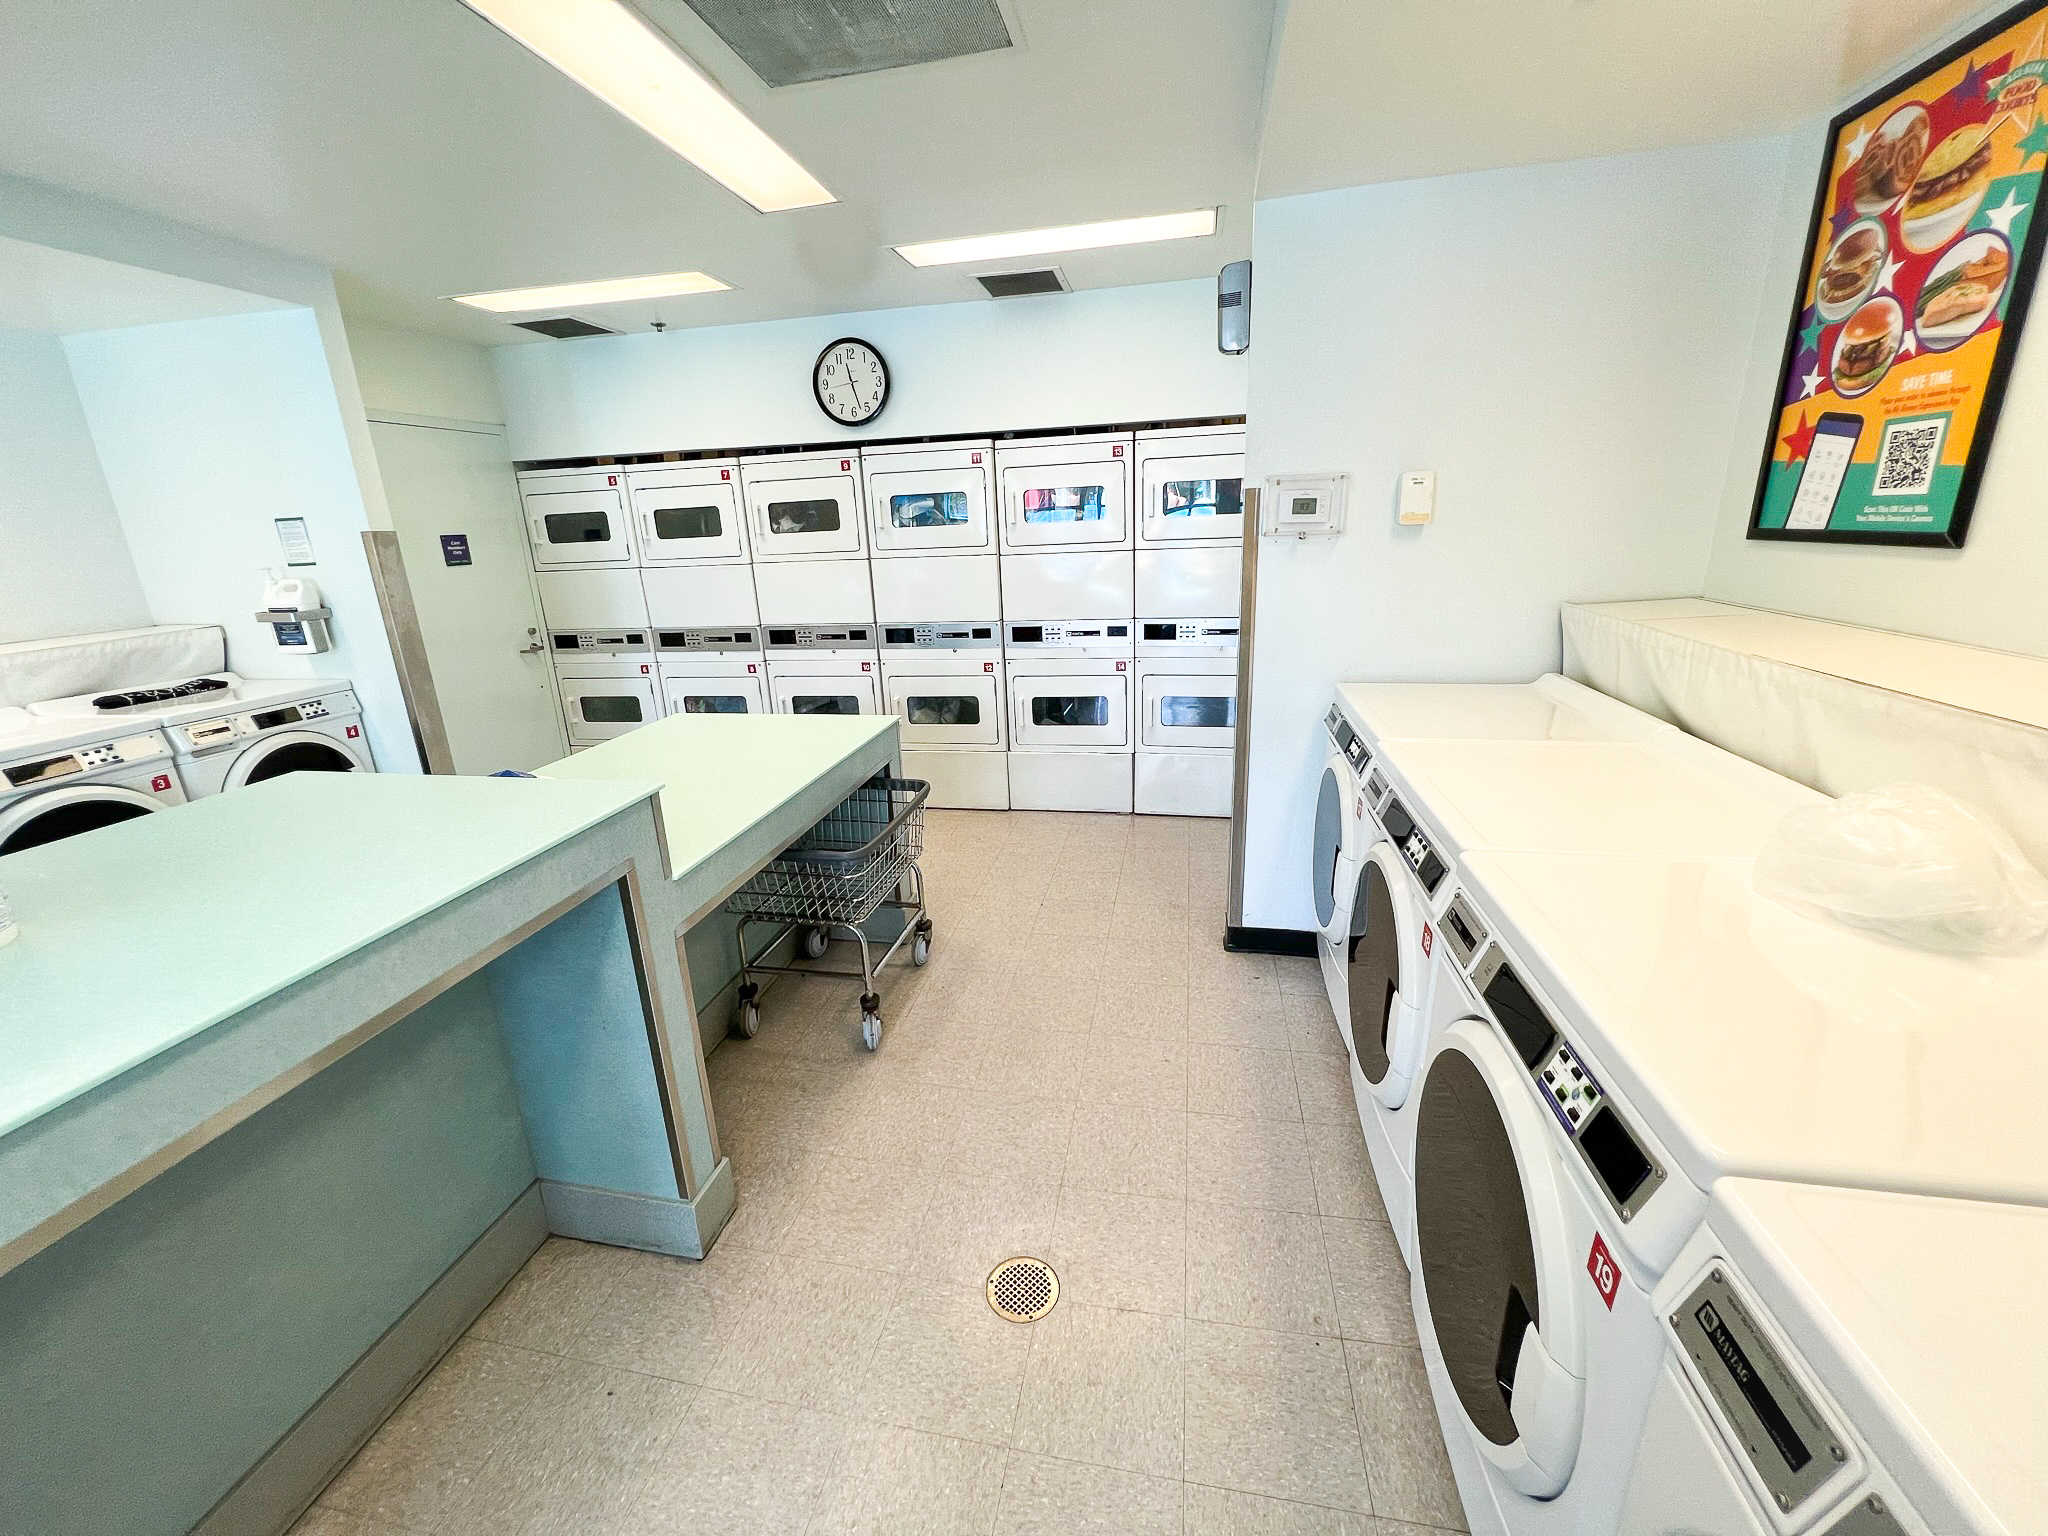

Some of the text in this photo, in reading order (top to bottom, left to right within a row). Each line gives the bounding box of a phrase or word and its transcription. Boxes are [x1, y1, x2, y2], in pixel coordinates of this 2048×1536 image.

[835, 353, 843, 365] 11
[846, 347, 855, 360] 12
[826, 364, 835, 376] 10
[871, 362, 877, 373] 2
[822, 379, 829, 390] 9
[875, 375, 882, 387] 3
[1901, 369, 1954, 391] SAVE TIME
[828, 393, 835, 404] 8
[872, 391, 878, 401] 4
[839, 403, 845, 414] 7
[851, 407, 857, 417] 6
[864, 402, 871, 412] 5
[1300, 503, 1310, 511] 83
[1117, 663, 1125, 671] 14
[157, 780, 165, 788] 3
[1424, 932, 1430, 951] 18
[1595, 1252, 1614, 1294] 19
[1713, 1328, 1751, 1383] MAYTAG
